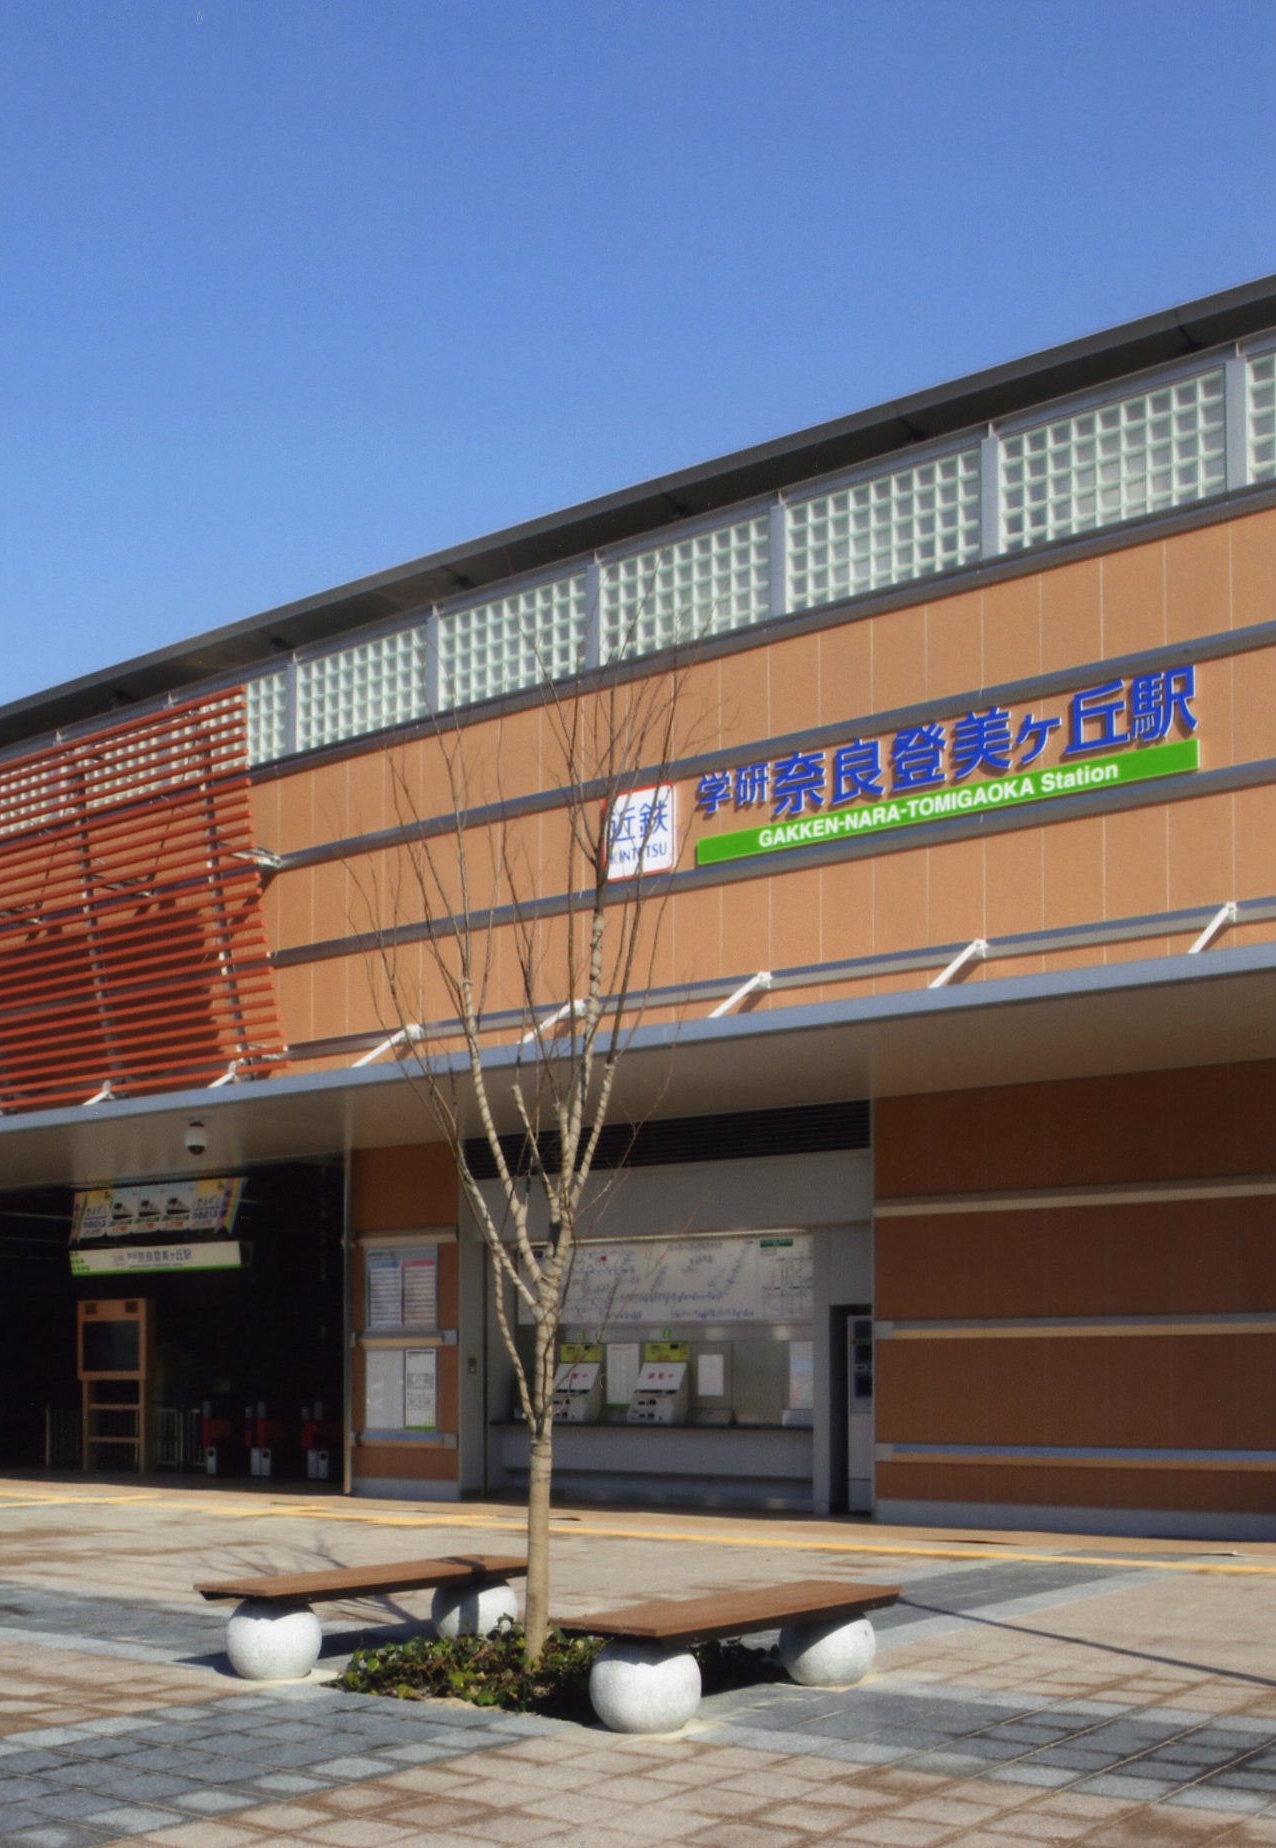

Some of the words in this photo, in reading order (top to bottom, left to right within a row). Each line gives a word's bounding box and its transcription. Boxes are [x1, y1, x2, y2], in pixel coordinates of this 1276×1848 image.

[609, 800, 669, 842] 近鉄
[758, 777, 1035, 848] GAKKEN-NARA-TOMIGAOKA
[1040, 763, 1119, 793] Station
[609, 841, 668, 865] KINTTSU
